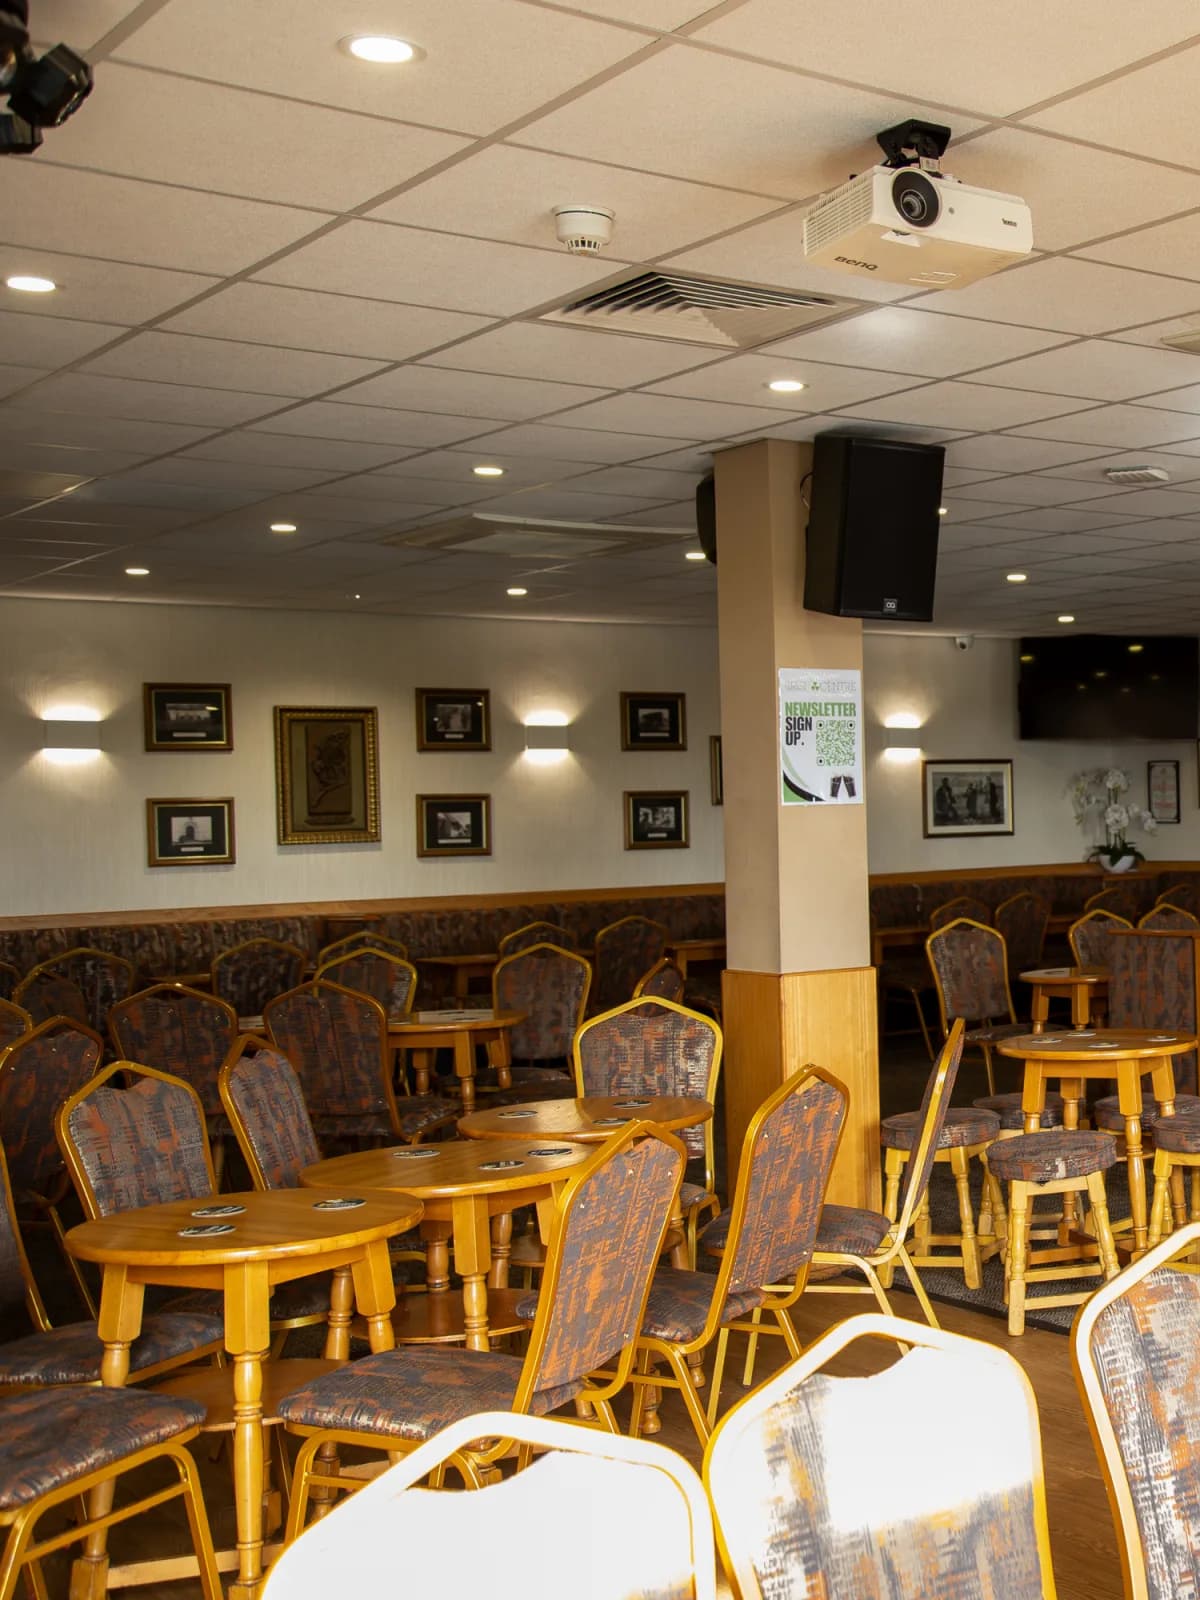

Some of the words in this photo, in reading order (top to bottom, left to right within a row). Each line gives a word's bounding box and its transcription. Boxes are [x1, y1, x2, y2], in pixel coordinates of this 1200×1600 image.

[785, 702, 856, 717] NEWSLETTER
[785, 716, 812, 731] SIGN
[785, 731, 805, 745] UP.
